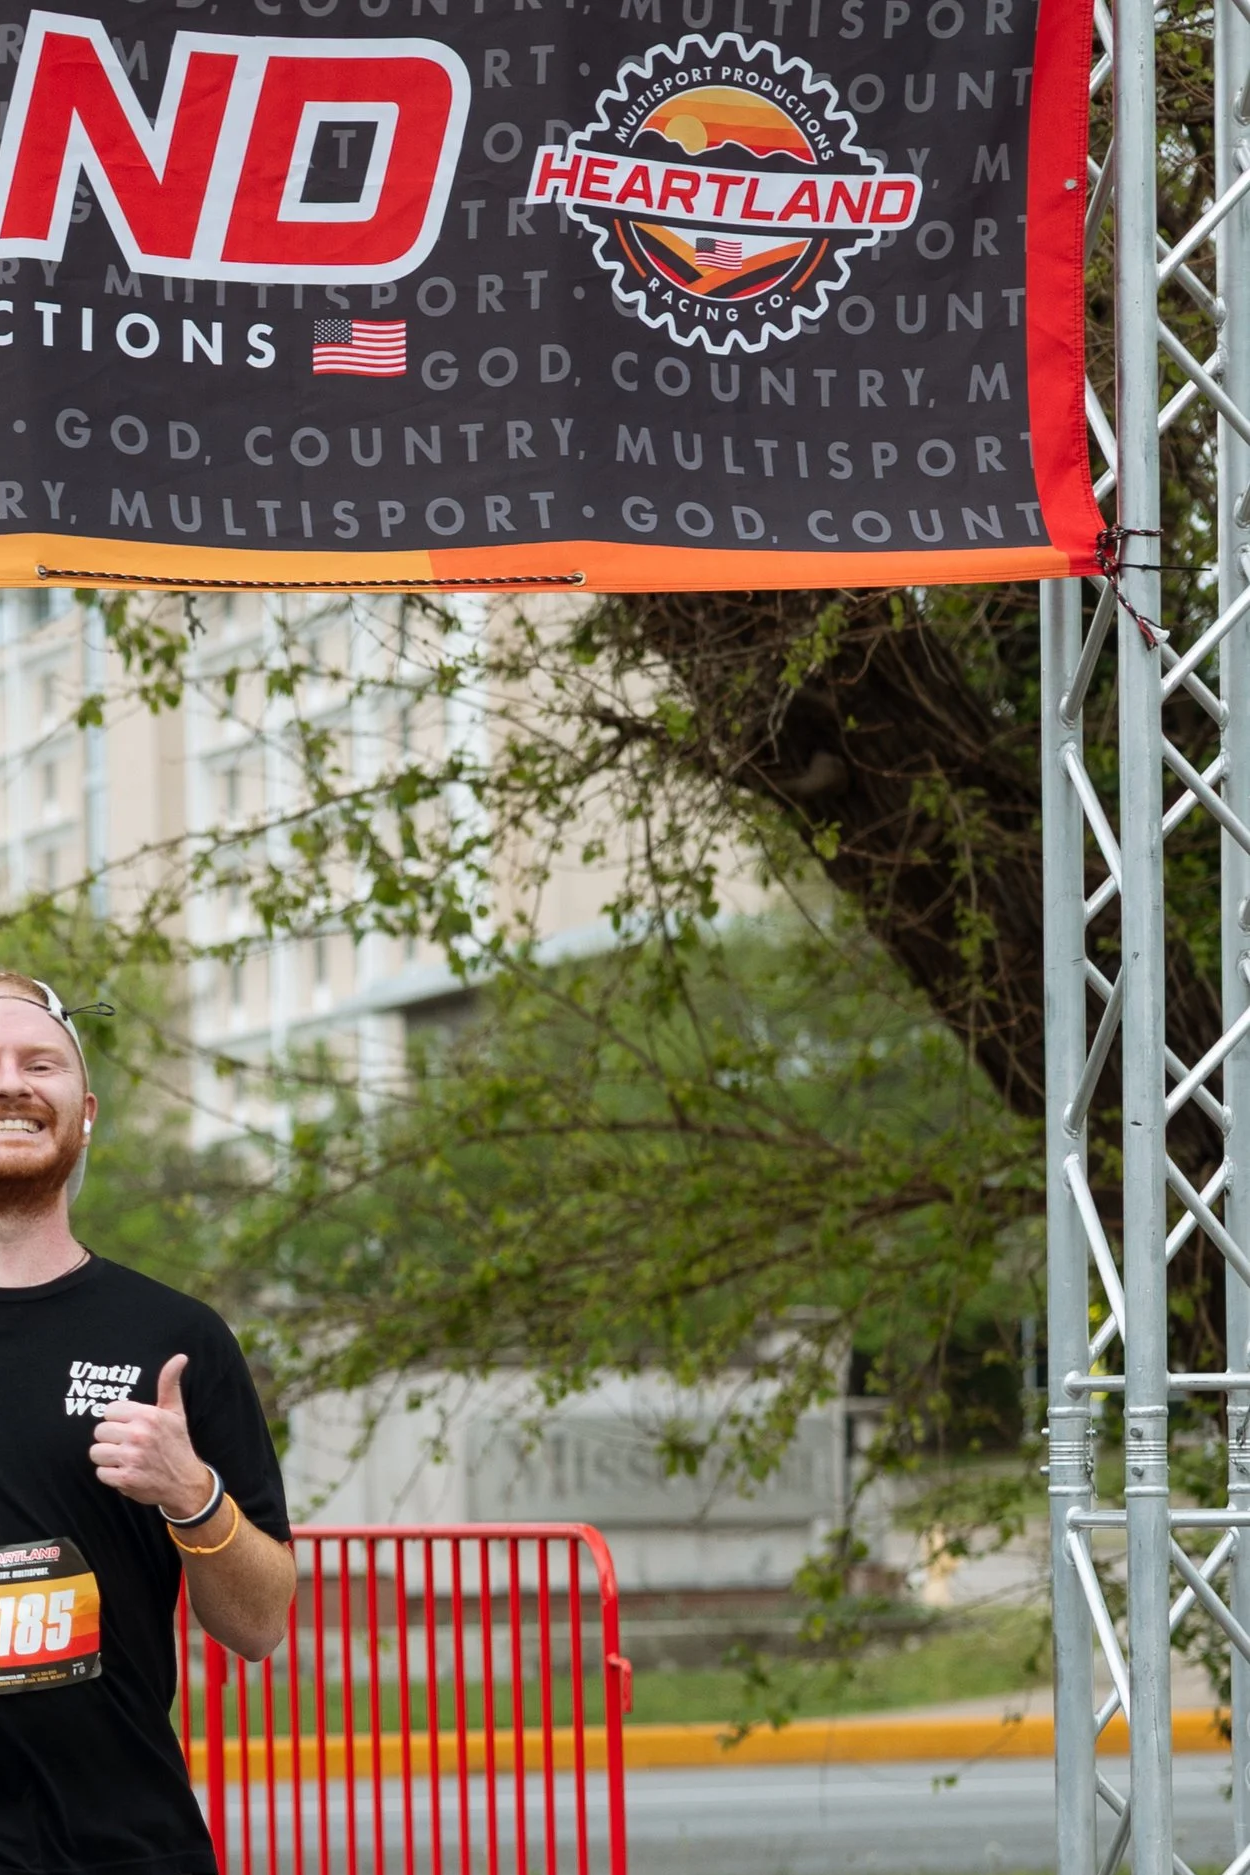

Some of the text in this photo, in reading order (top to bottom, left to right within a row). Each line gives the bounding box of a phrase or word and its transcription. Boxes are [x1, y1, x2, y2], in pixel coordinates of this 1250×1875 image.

[613, 65, 713, 144] MULTISPORT
[720, 65, 836, 163] PRODUCTIONS
[532, 151, 919, 225] HEARTLAND
[647, 277, 740, 322] RACING
[754, 293, 792, 317] CO.
[421, 343, 581, 391] GOD,
[611, 351, 936, 409] COUNTRY,
[55, 407, 212, 466] GOD,
[244, 417, 586, 468] COUNTRY,
[109, 488, 556, 540] MULTISPORT
[621, 495, 779, 544] GOD,
[66, 1379, 133, 1402] Next
[69, 1360, 142, 1385] Until
[64, 1397, 108, 1418] We
